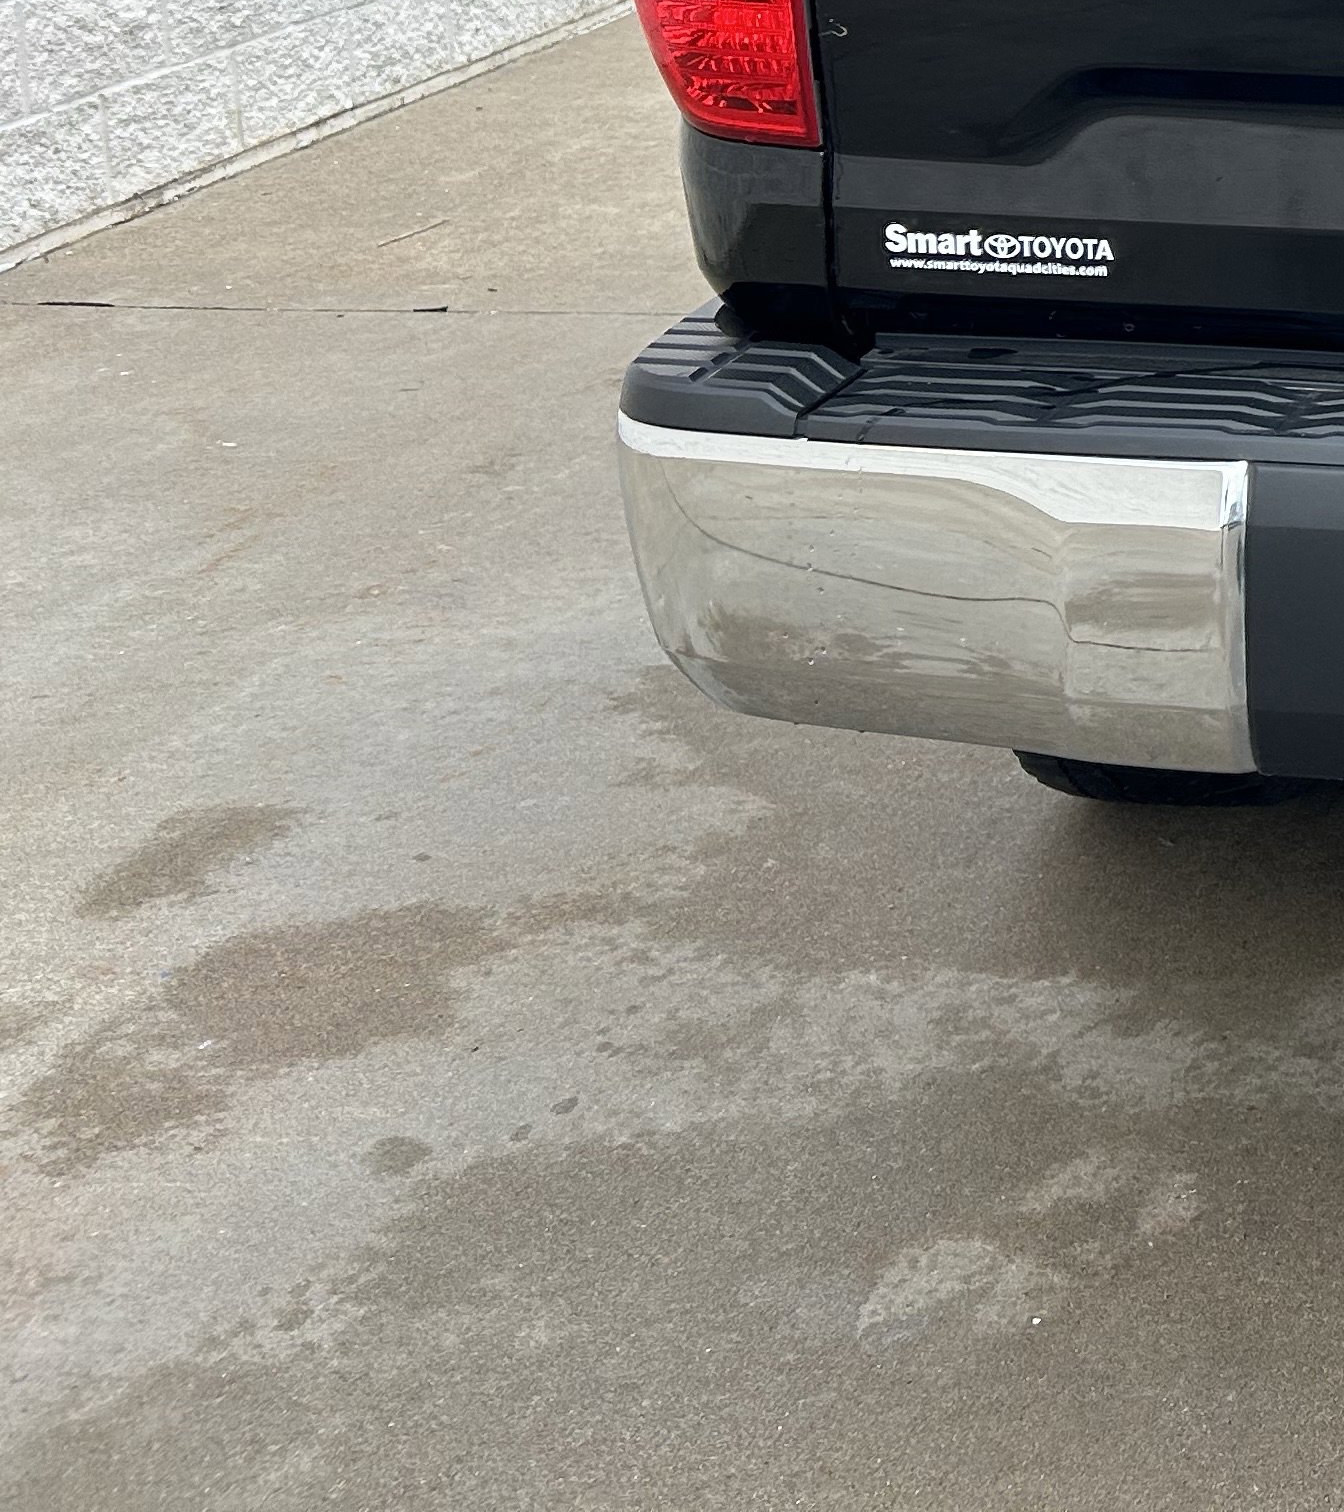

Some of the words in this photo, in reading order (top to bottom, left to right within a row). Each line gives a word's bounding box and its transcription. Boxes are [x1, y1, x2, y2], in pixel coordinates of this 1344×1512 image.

[885, 223, 983, 257] Smart
[1018, 235, 1114, 261] TOYOTA
[889, 257, 1108, 277] www.smarttoyotaquadcities.com
